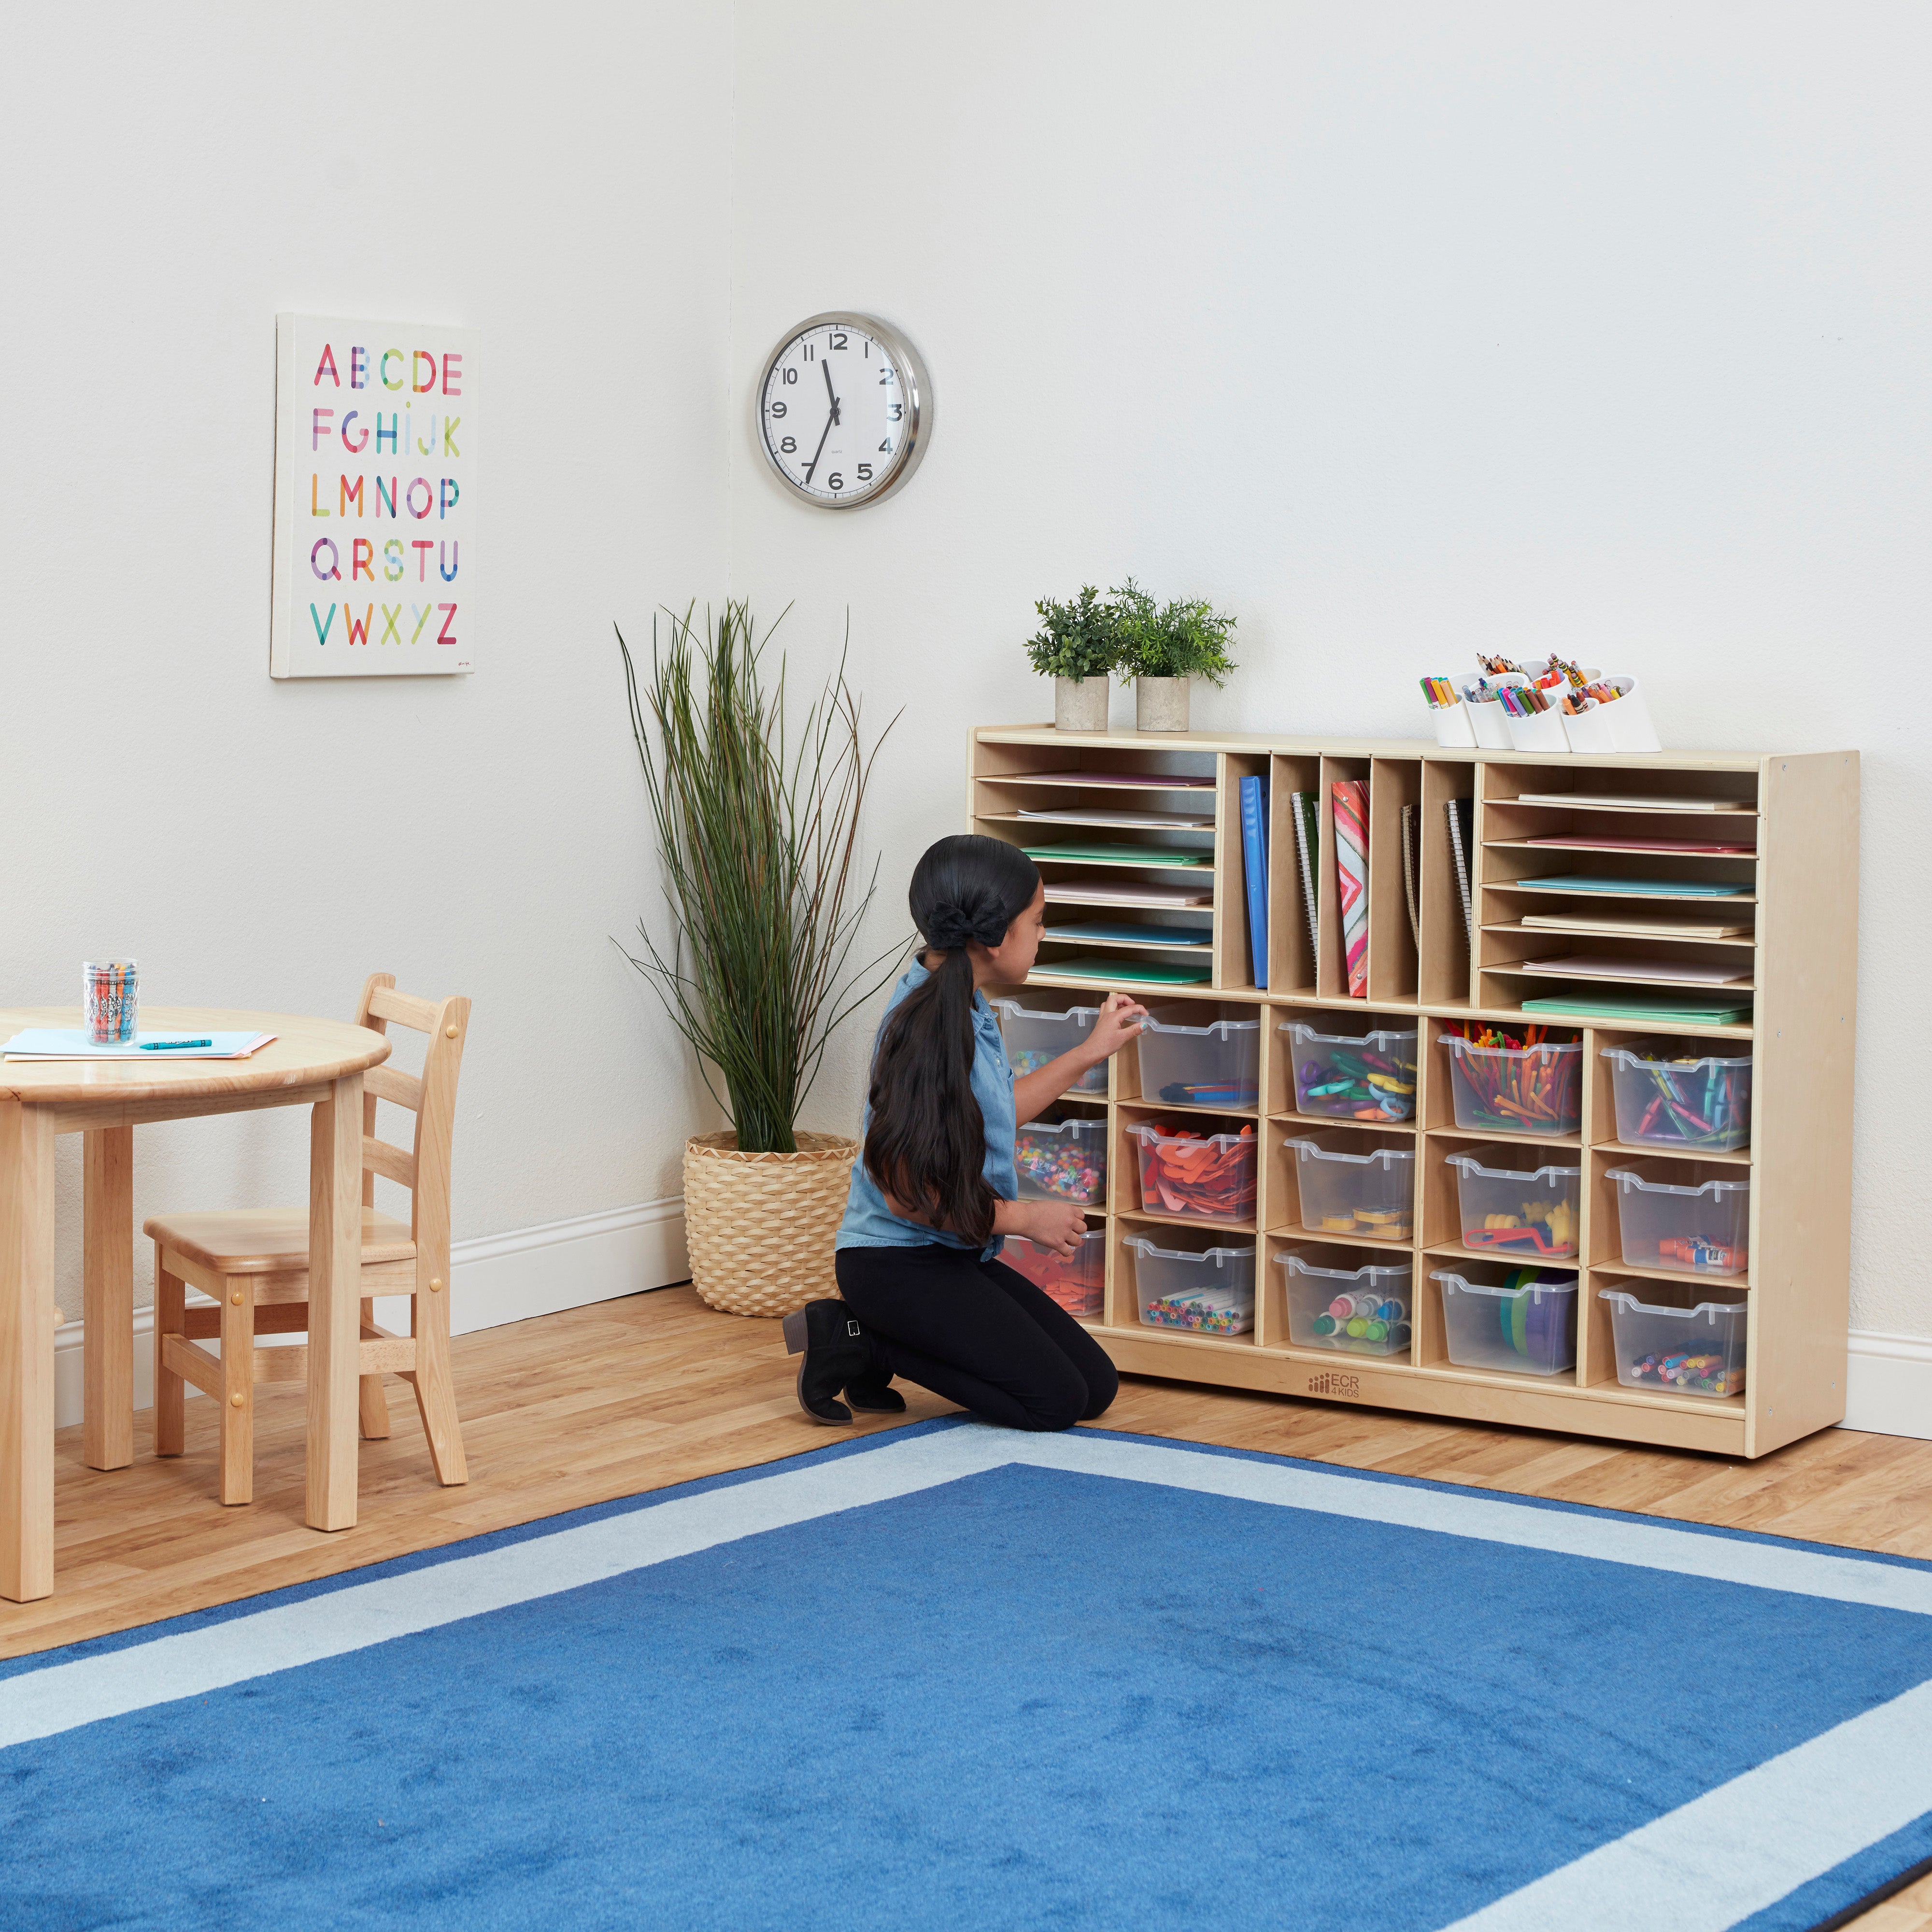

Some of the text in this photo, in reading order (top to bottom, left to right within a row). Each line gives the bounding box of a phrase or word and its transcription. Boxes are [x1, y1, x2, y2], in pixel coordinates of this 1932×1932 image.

[829, 333, 848, 350] 12
[865, 341, 868, 358] 1
[804, 344, 814, 361] 11
[782, 368, 798, 384] 10
[879, 368, 894, 385] 2
[771, 401, 787, 418] 9
[887, 404, 902, 422] 3
[780, 436, 797, 454] 8
[878, 437, 893, 455] 4
[801, 463, 815, 481] 7
[857, 463, 873, 481] 5
[828, 472, 844, 490] 6
[1331, 1374, 1359, 1389] ECR
[1331, 1387, 1359, 1398] 4 KIDS
